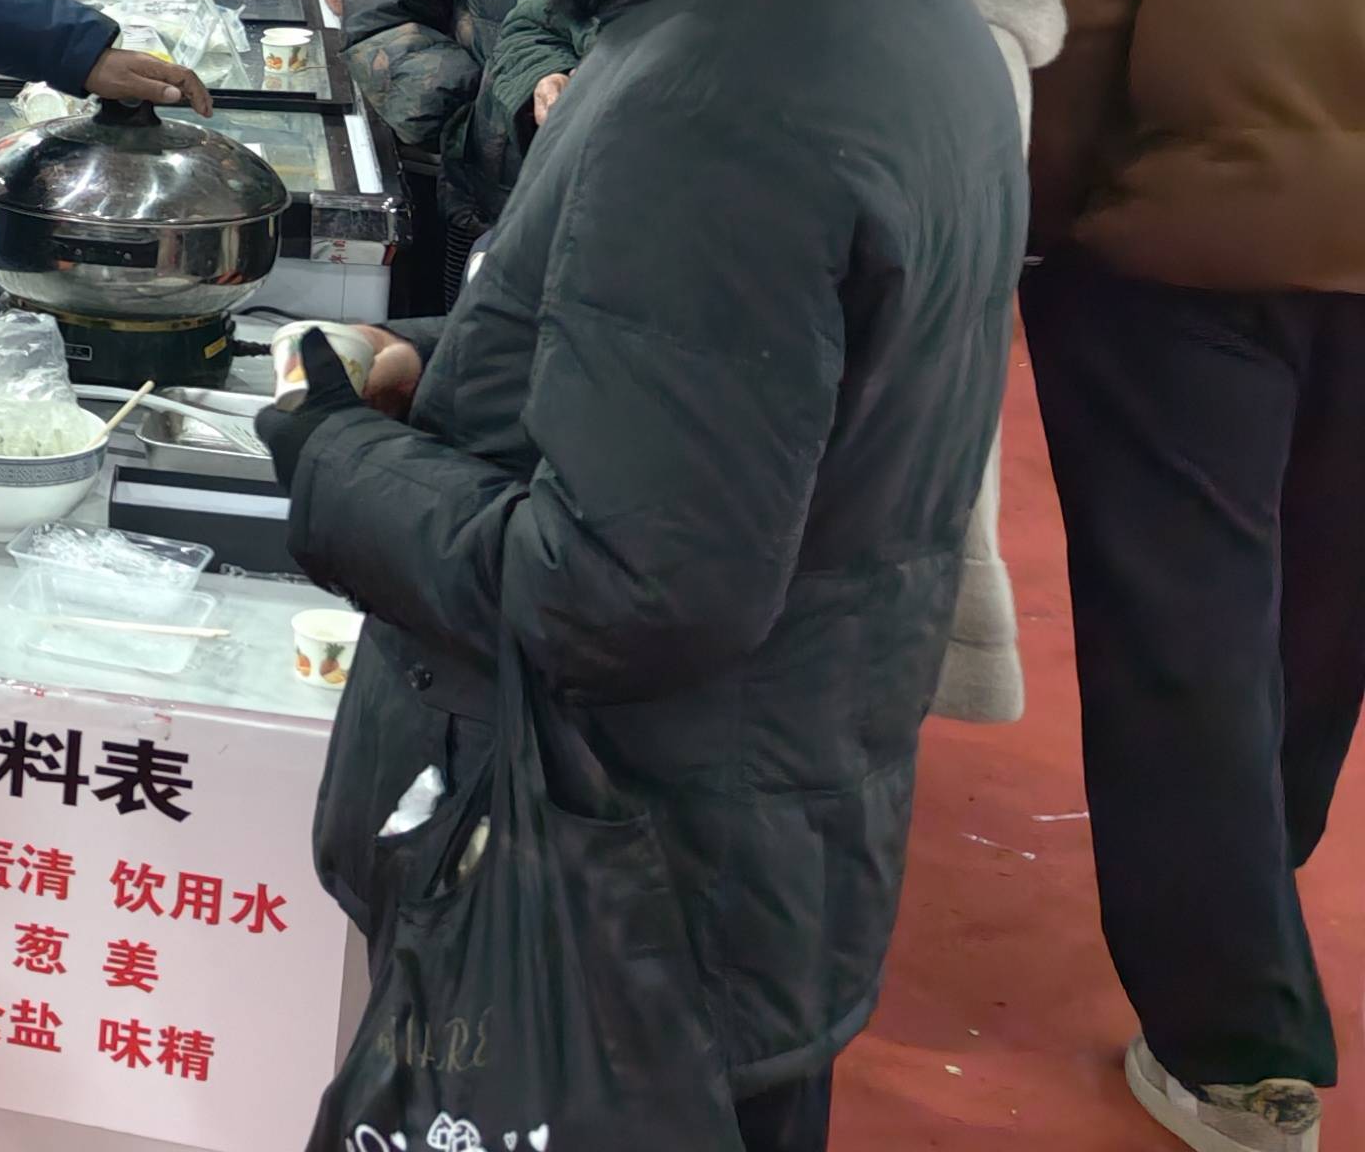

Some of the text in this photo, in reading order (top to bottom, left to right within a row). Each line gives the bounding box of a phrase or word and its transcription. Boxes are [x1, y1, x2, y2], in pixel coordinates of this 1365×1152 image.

[109, 857, 292, 935] 饮用水
[11, 921, 70, 975] 葱
[101, 938, 162, 995] 姜
[97, 1016, 217, 1083] 味精
